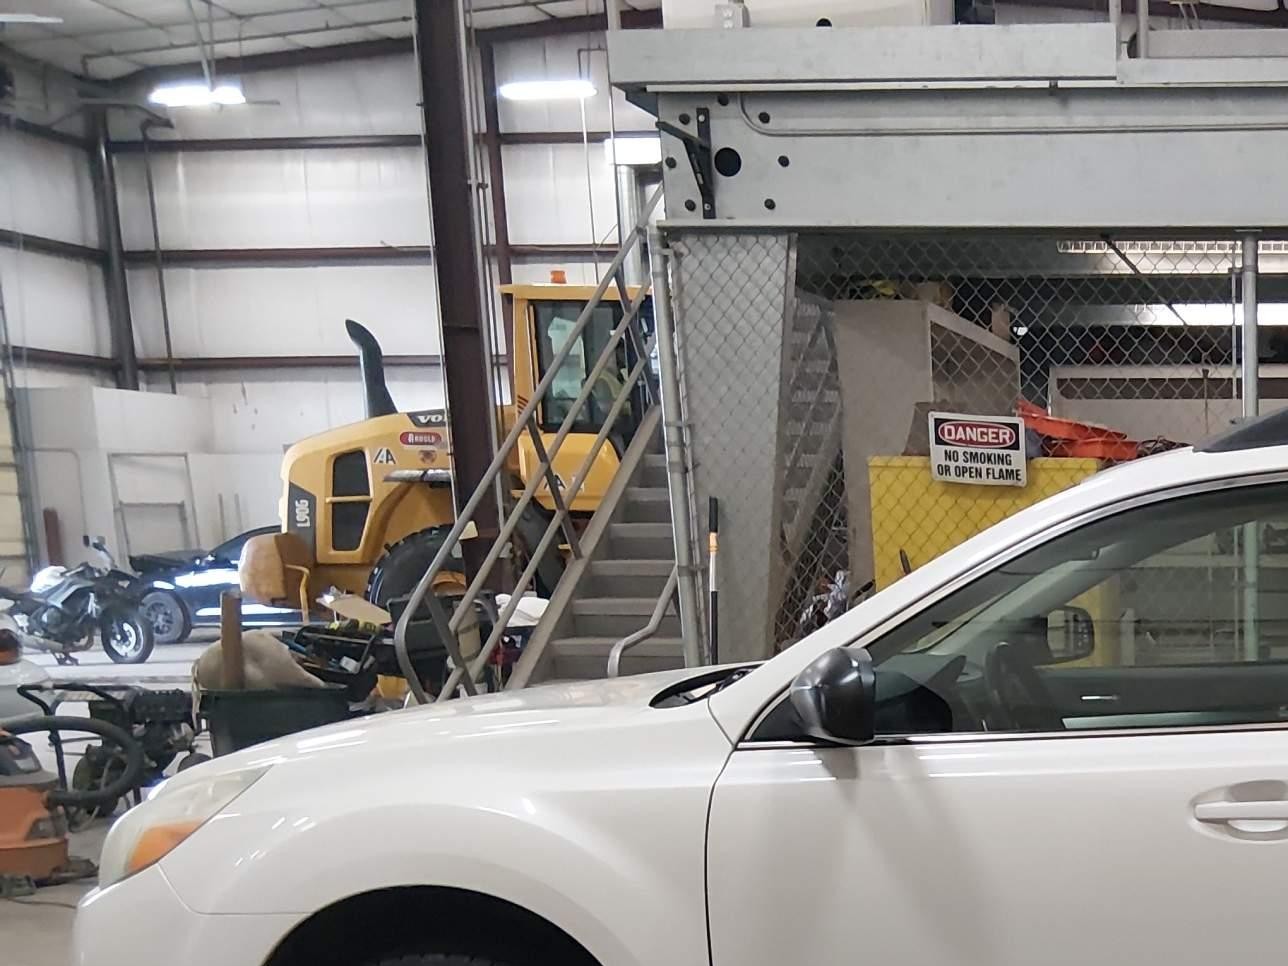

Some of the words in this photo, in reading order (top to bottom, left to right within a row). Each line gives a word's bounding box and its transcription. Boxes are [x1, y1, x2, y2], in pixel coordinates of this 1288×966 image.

[944, 425, 1011, 443] DANGER
[944, 449, 959, 463] NO
[962, 451, 1012, 466] SMOKING
[937, 464, 951, 477] OR
[954, 466, 983, 479] OPEN
[986, 467, 1022, 481] FLAME
